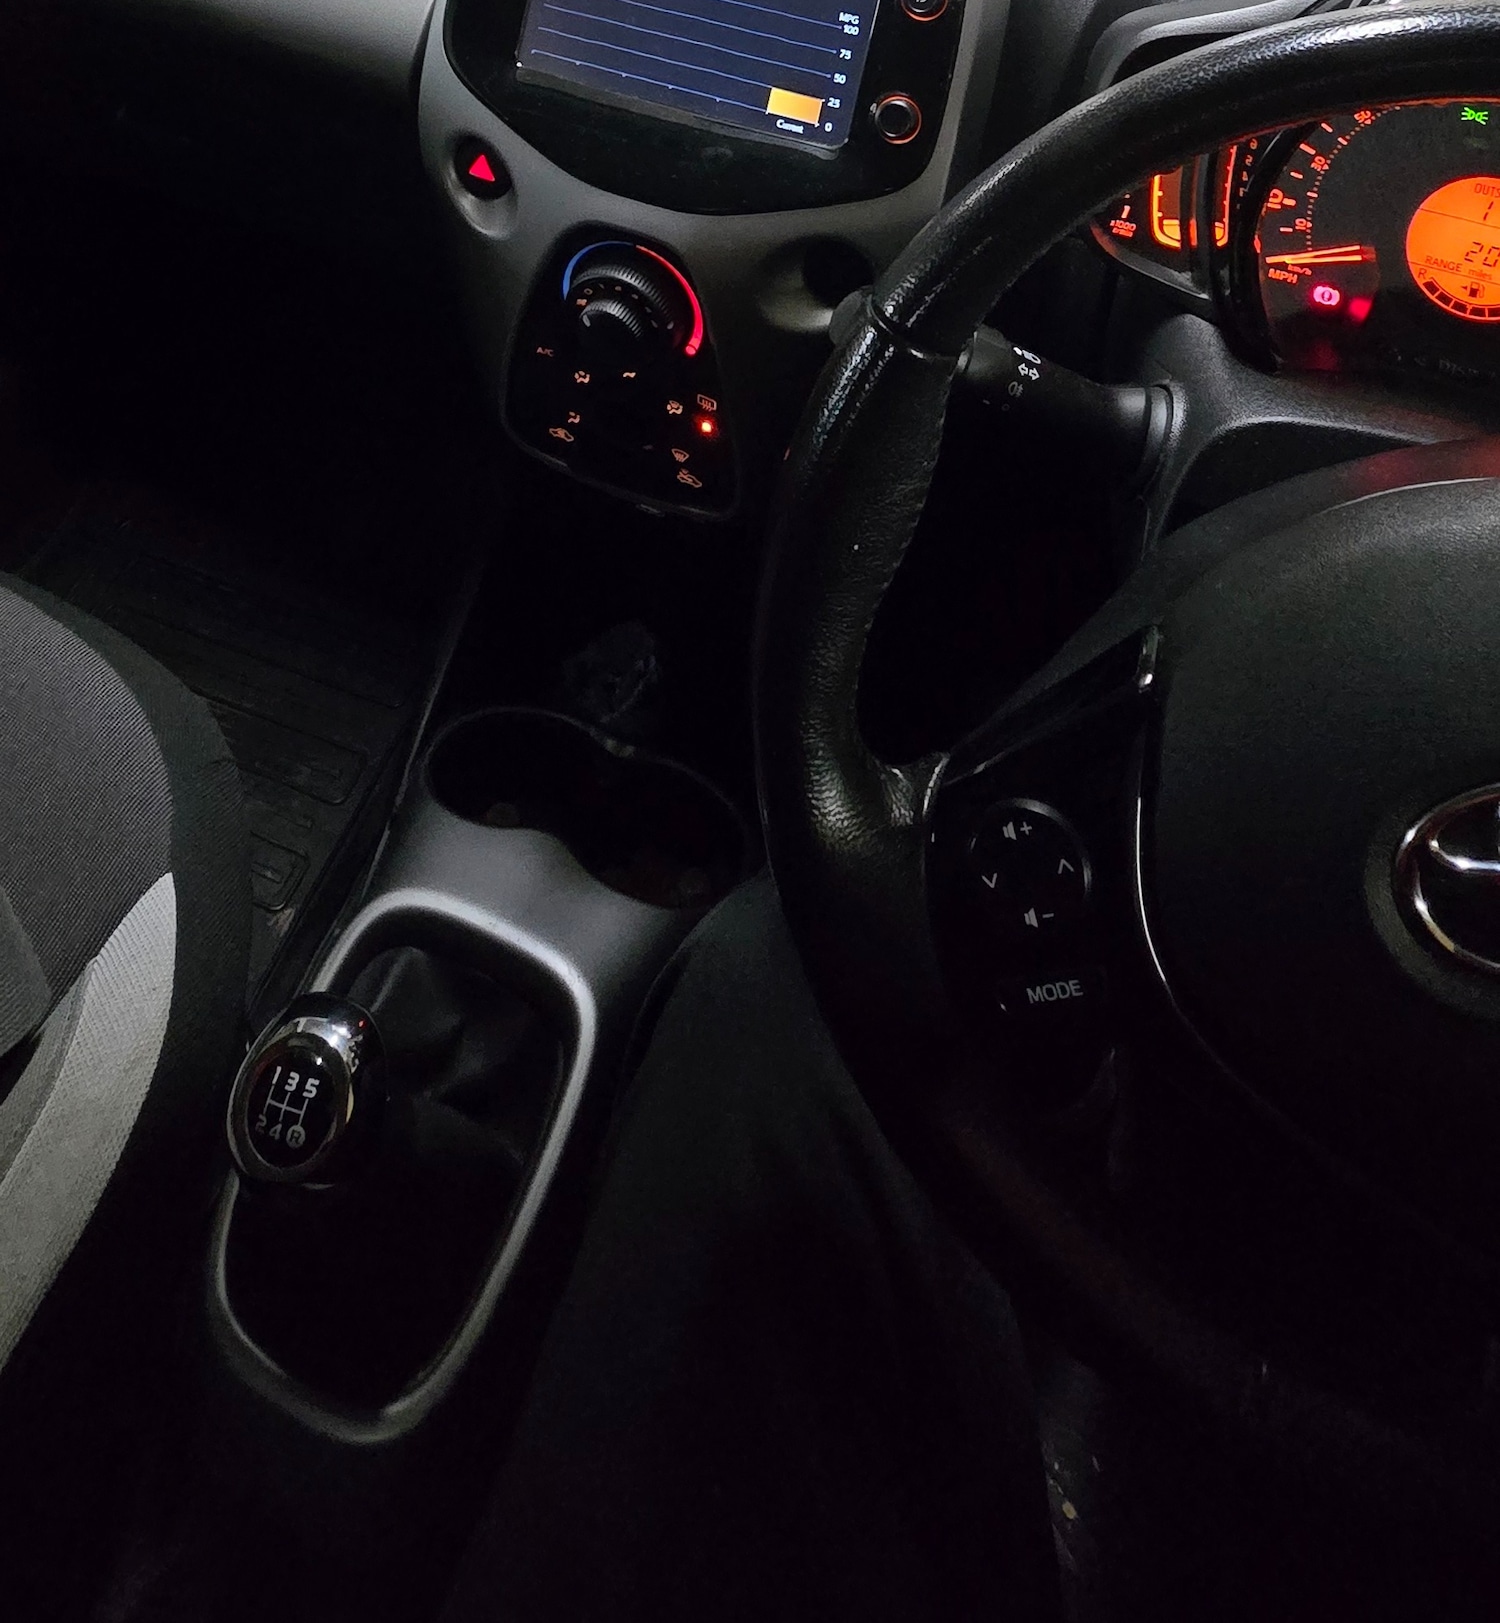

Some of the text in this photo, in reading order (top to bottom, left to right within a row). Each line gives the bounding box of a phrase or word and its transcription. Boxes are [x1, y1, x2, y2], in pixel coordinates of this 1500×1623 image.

[843, 24, 860, 36] 100
[839, 48, 852, 60] 75
[833, 73, 847, 84] 50
[827, 97, 840, 109] 25
[824, 122, 833, 132] 0
[1424, 255, 1493, 281] RANGE miles
[1268, 268, 1298, 284] MPH
[1026, 979, 1084, 1004] MODE
[272, 1066, 320, 1099] 1 3 5
[255, 1114, 268, 1133] 2
[269, 1122, 283, 1140] 4
